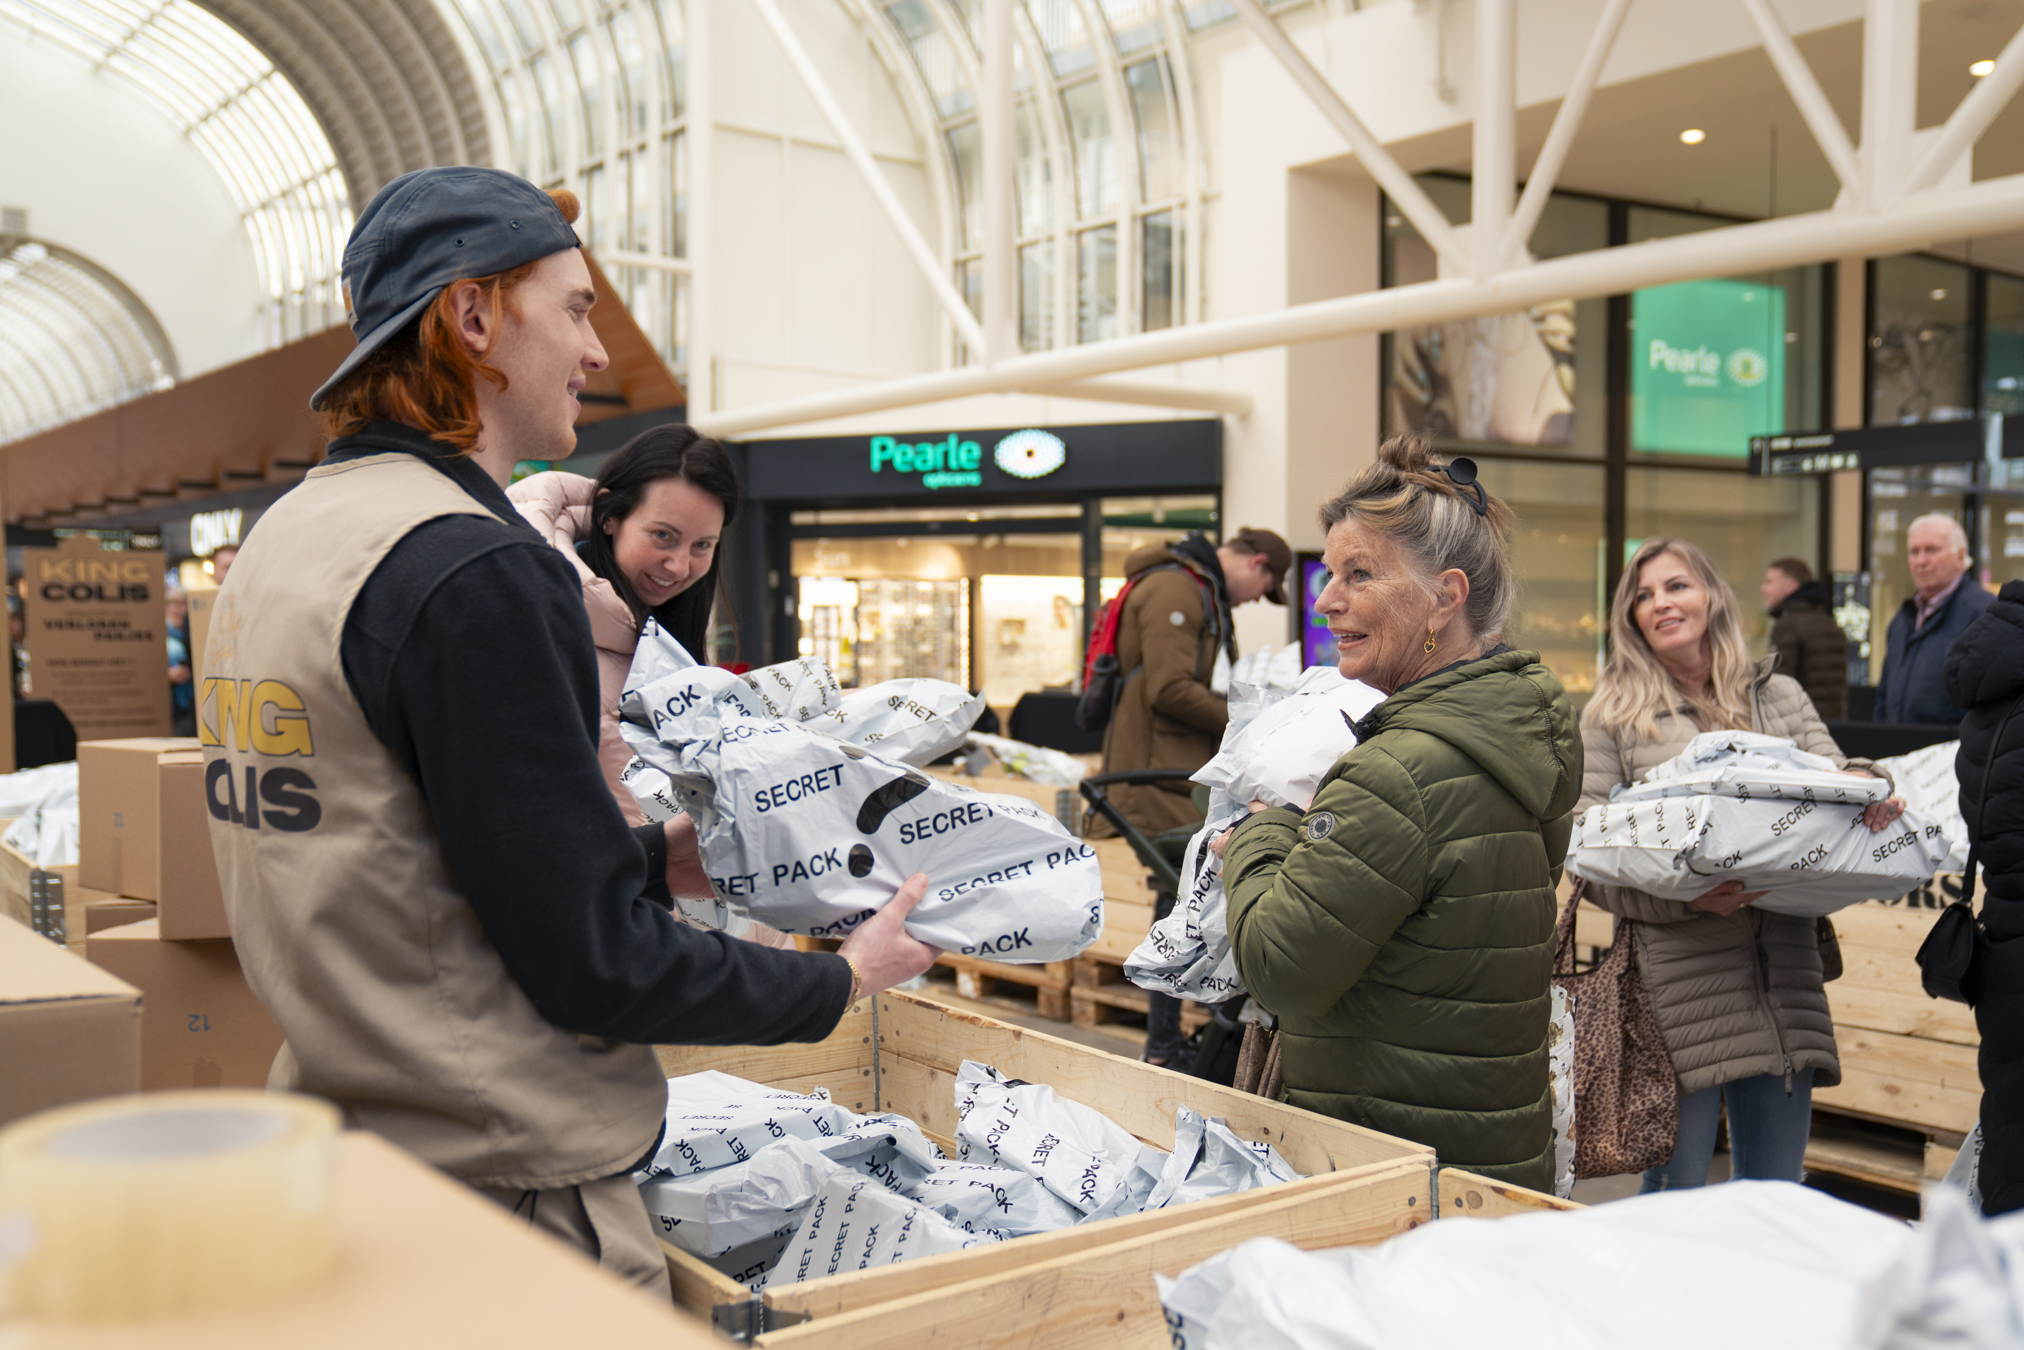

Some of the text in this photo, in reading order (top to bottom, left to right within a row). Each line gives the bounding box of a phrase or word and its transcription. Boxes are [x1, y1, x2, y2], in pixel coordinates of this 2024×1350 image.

[1649, 338, 1721, 376] Pearle
[870, 432, 982, 473] Pearle
[190, 507, 242, 557] ONLY
[38, 557, 150, 583] KING
[41, 582, 149, 603] COLIS
[767, 667, 794, 692] PACK
[824, 709, 848, 723] CK
[888, 694, 938, 722] SERET
[754, 763, 844, 813] SECRET
[899, 802, 994, 845] SECRET
[1625, 806, 1640, 848] ECRET
[1791, 843, 1830, 870] PACK
[1872, 830, 1920, 863] SECRET
[773, 847, 843, 887] PACK
[938, 859, 1034, 902] SECRET
[1188, 867, 1217, 913] PACK
[961, 927, 1033, 956] PACK
[764, 1117, 786, 1139] CK
[968, 1180, 1014, 1214] PACK
[808, 1195, 829, 1240] PACK
[858, 1223, 880, 1270] PACK
